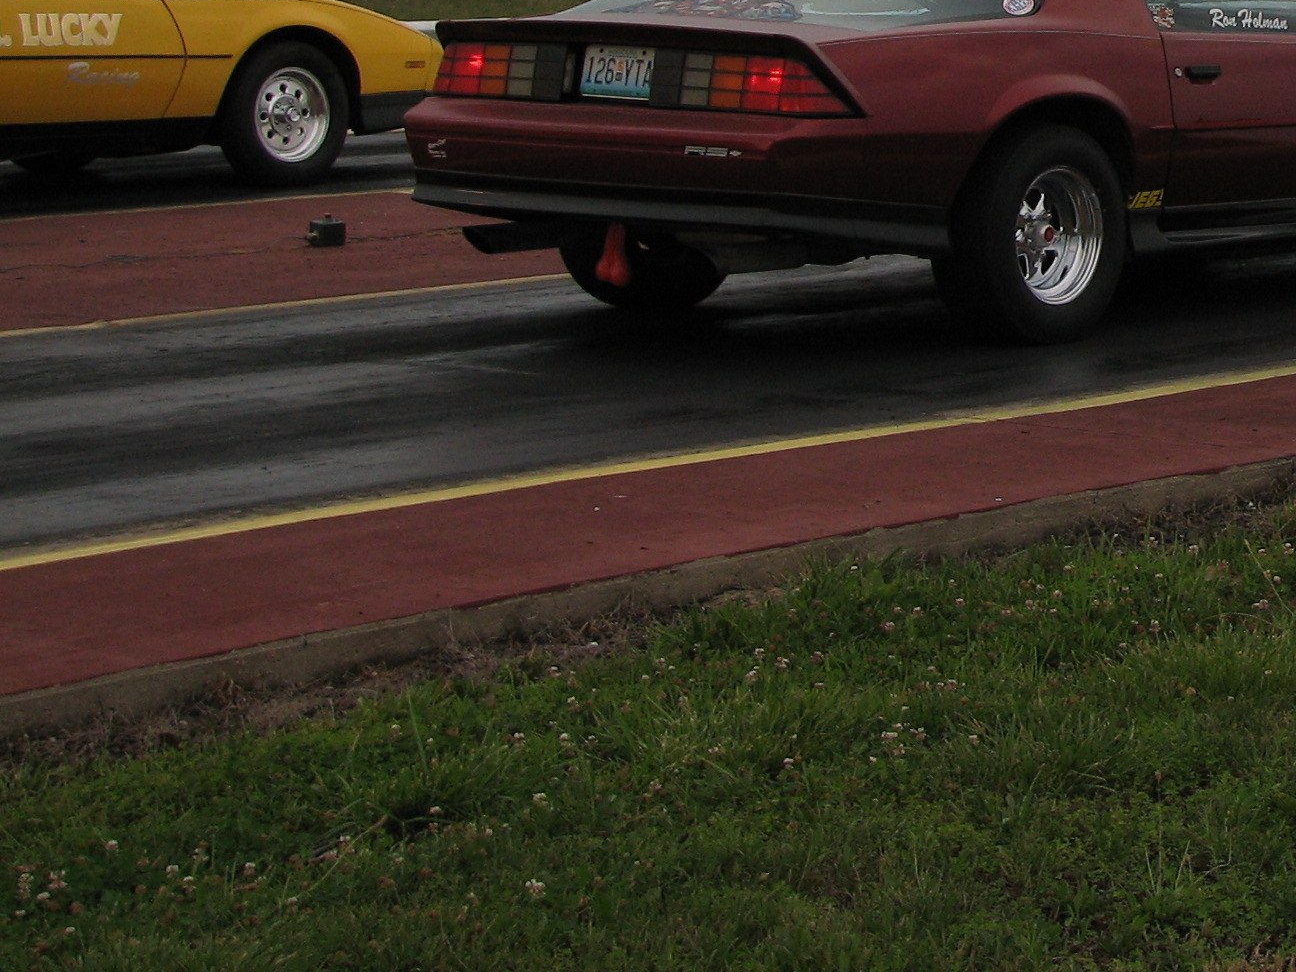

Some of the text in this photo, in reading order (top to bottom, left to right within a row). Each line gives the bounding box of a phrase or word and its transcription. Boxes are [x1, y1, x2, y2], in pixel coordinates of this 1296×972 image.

[18, 13, 122, 46] LUCKY
[1209, 8, 1288, 30] Ron Holman
[585, 56, 616, 84] 126
